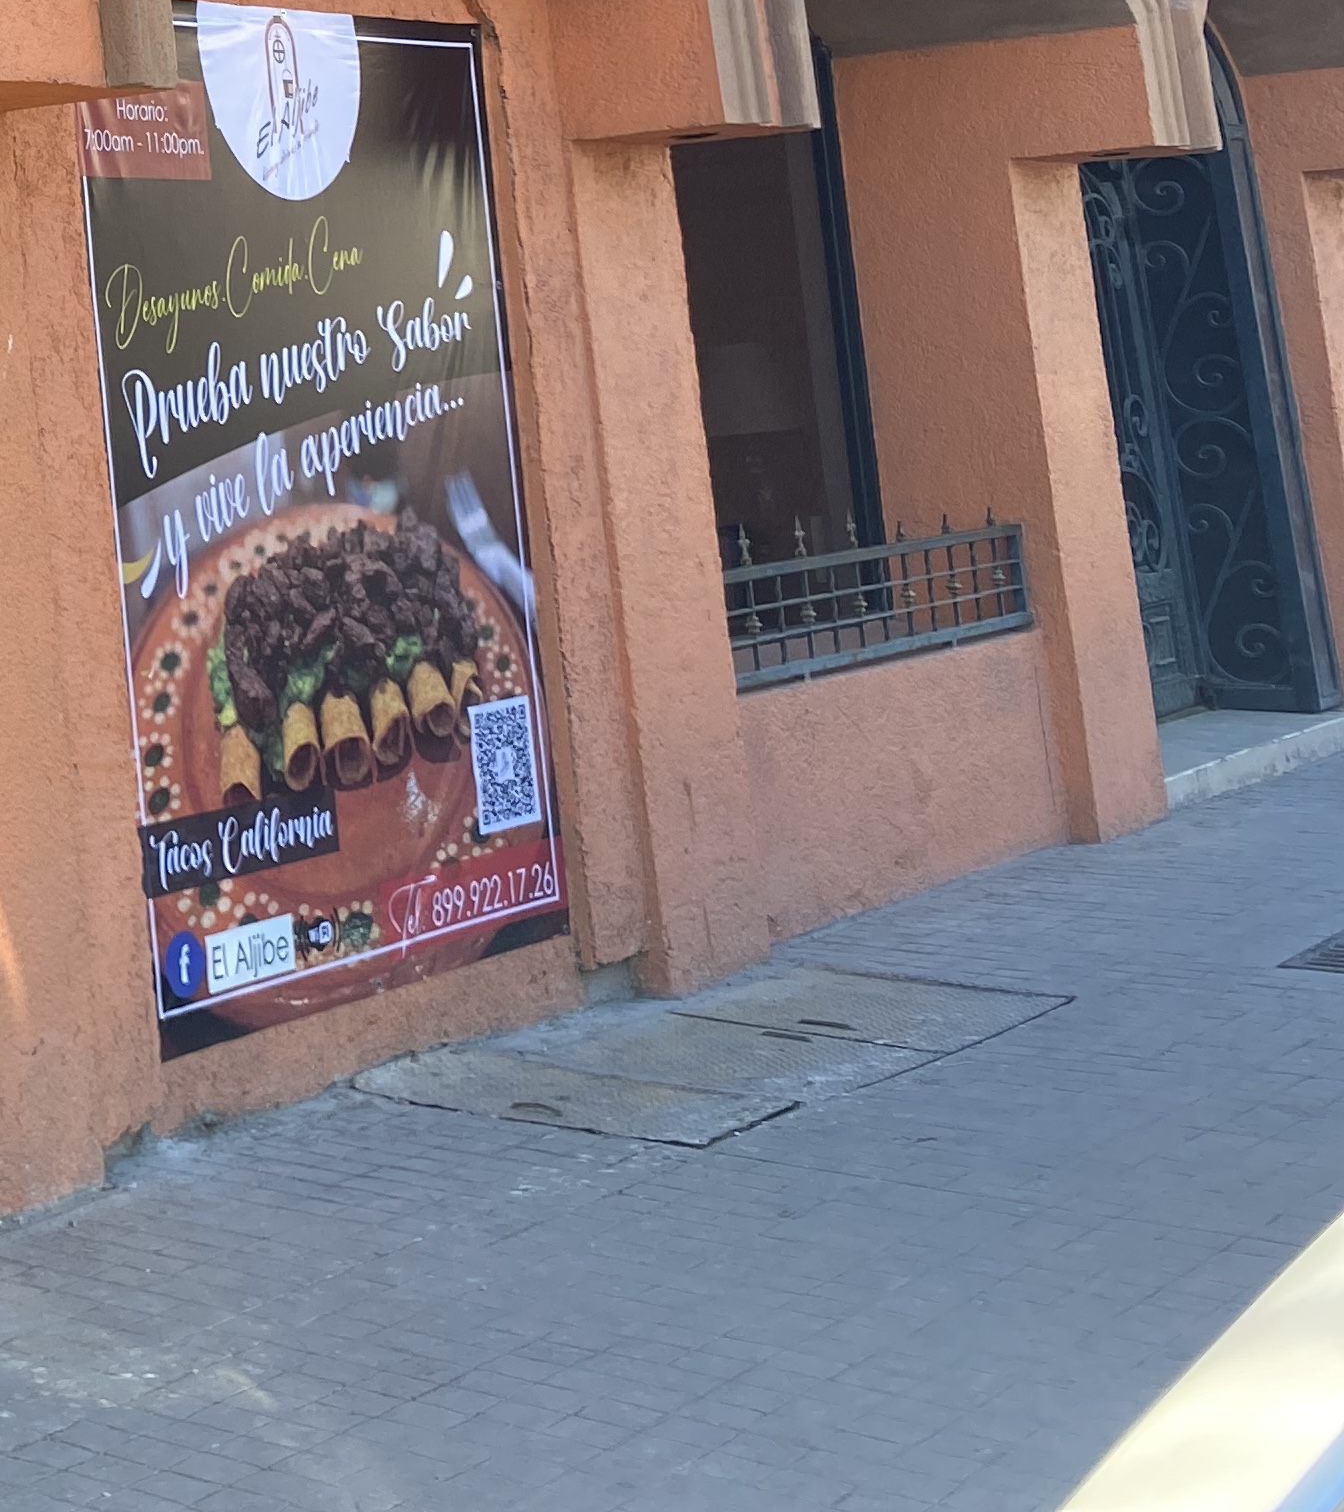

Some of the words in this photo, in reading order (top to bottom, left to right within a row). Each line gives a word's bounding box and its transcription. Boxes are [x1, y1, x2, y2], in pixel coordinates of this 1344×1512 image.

[83, 128, 135, 153] 7:00am
[116, 98, 169, 123] Horario:
[120, 340, 254, 480] Prueba
[259, 314, 372, 406] nuestro
[375, 299, 473, 373] Sabor
[194, 472, 251, 543] vive
[253, 431, 295, 517] la
[148, 827, 214, 893] Tacos
[216, 805, 336, 875] California
[431, 860, 556, 928] 899.922.17.26
[210, 942, 230, 981] El
[233, 930, 292, 978] Aljibe
